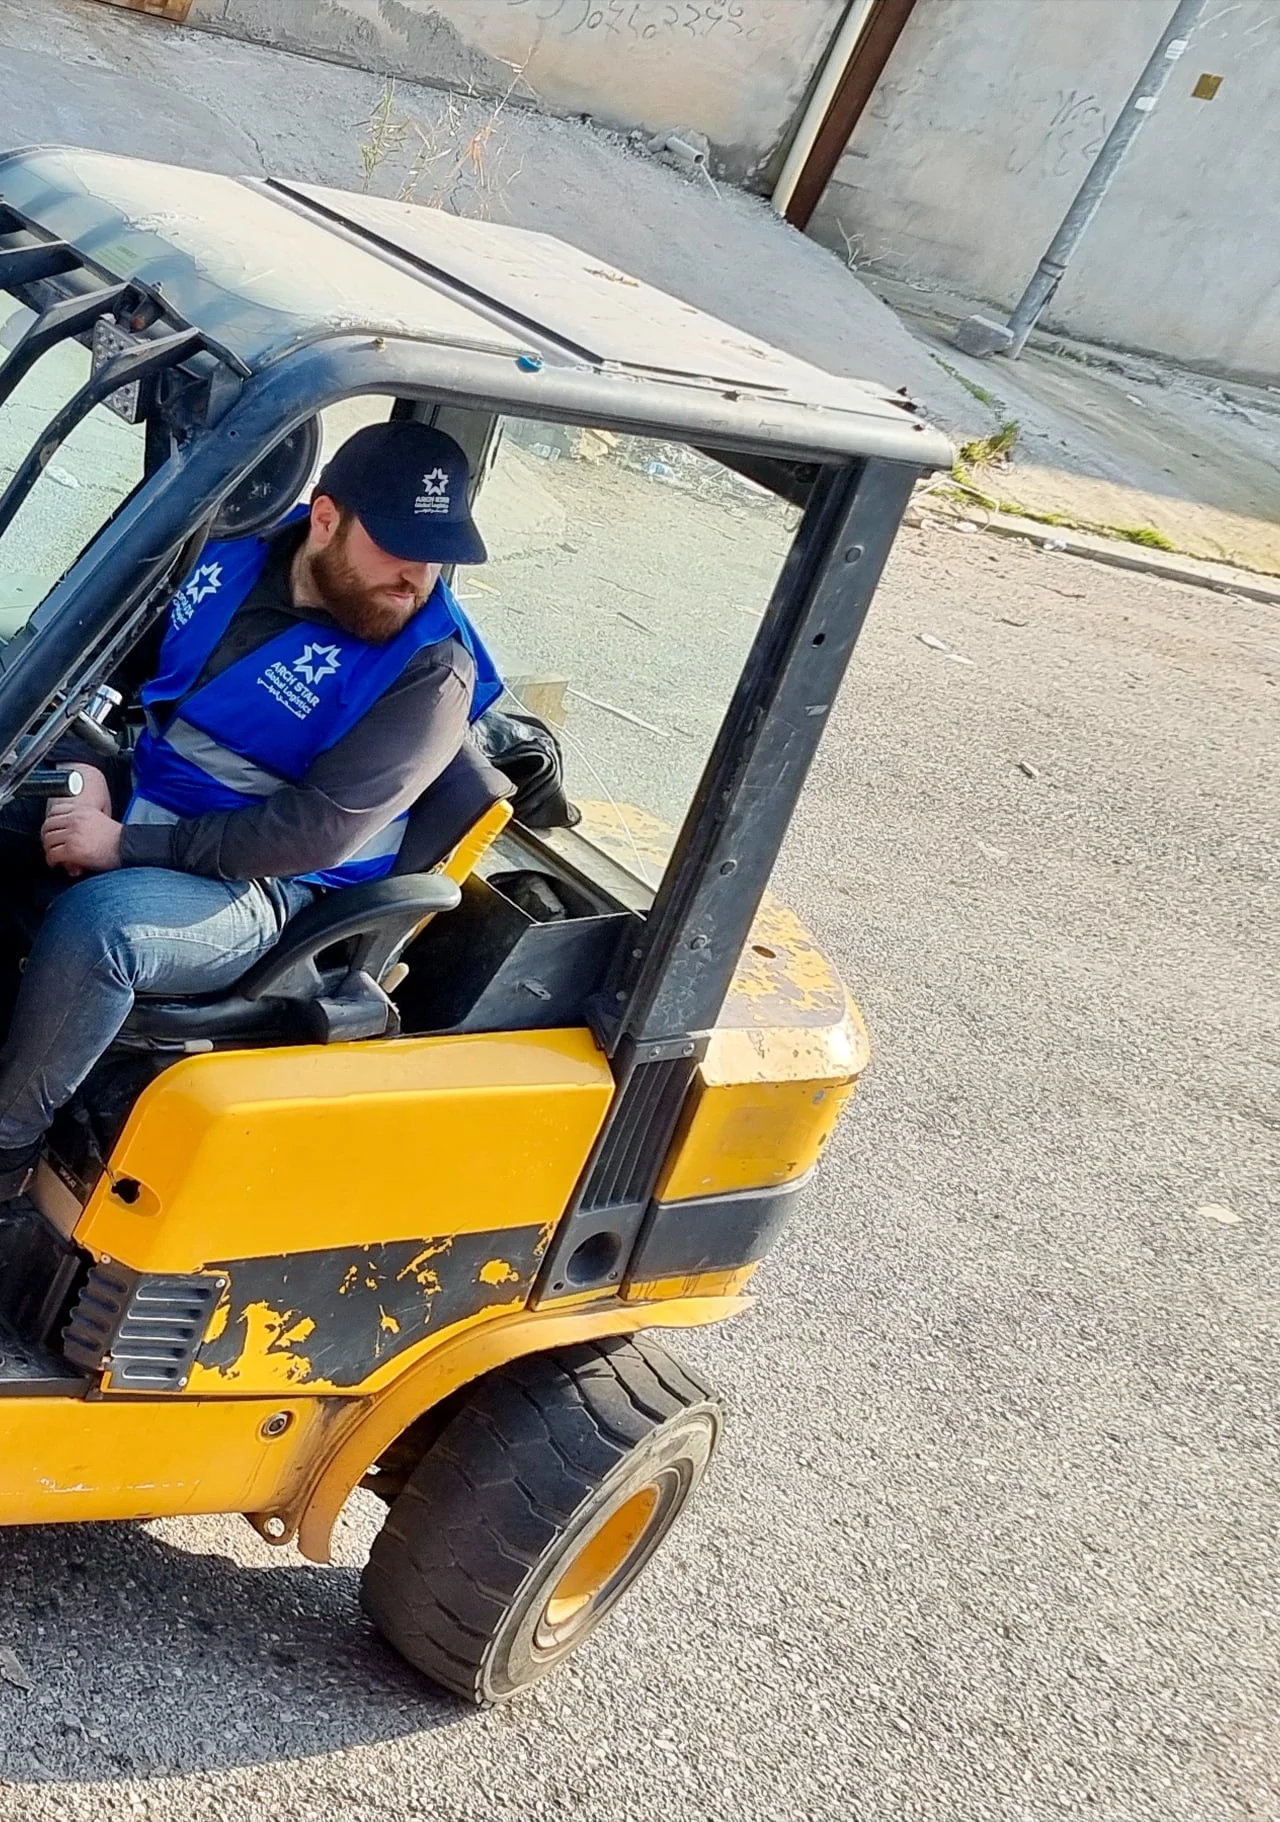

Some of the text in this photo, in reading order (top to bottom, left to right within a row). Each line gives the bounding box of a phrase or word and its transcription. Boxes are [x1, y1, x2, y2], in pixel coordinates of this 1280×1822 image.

[264, 668, 286, 690] Global
[270, 661, 320, 707] ARCH STAR
